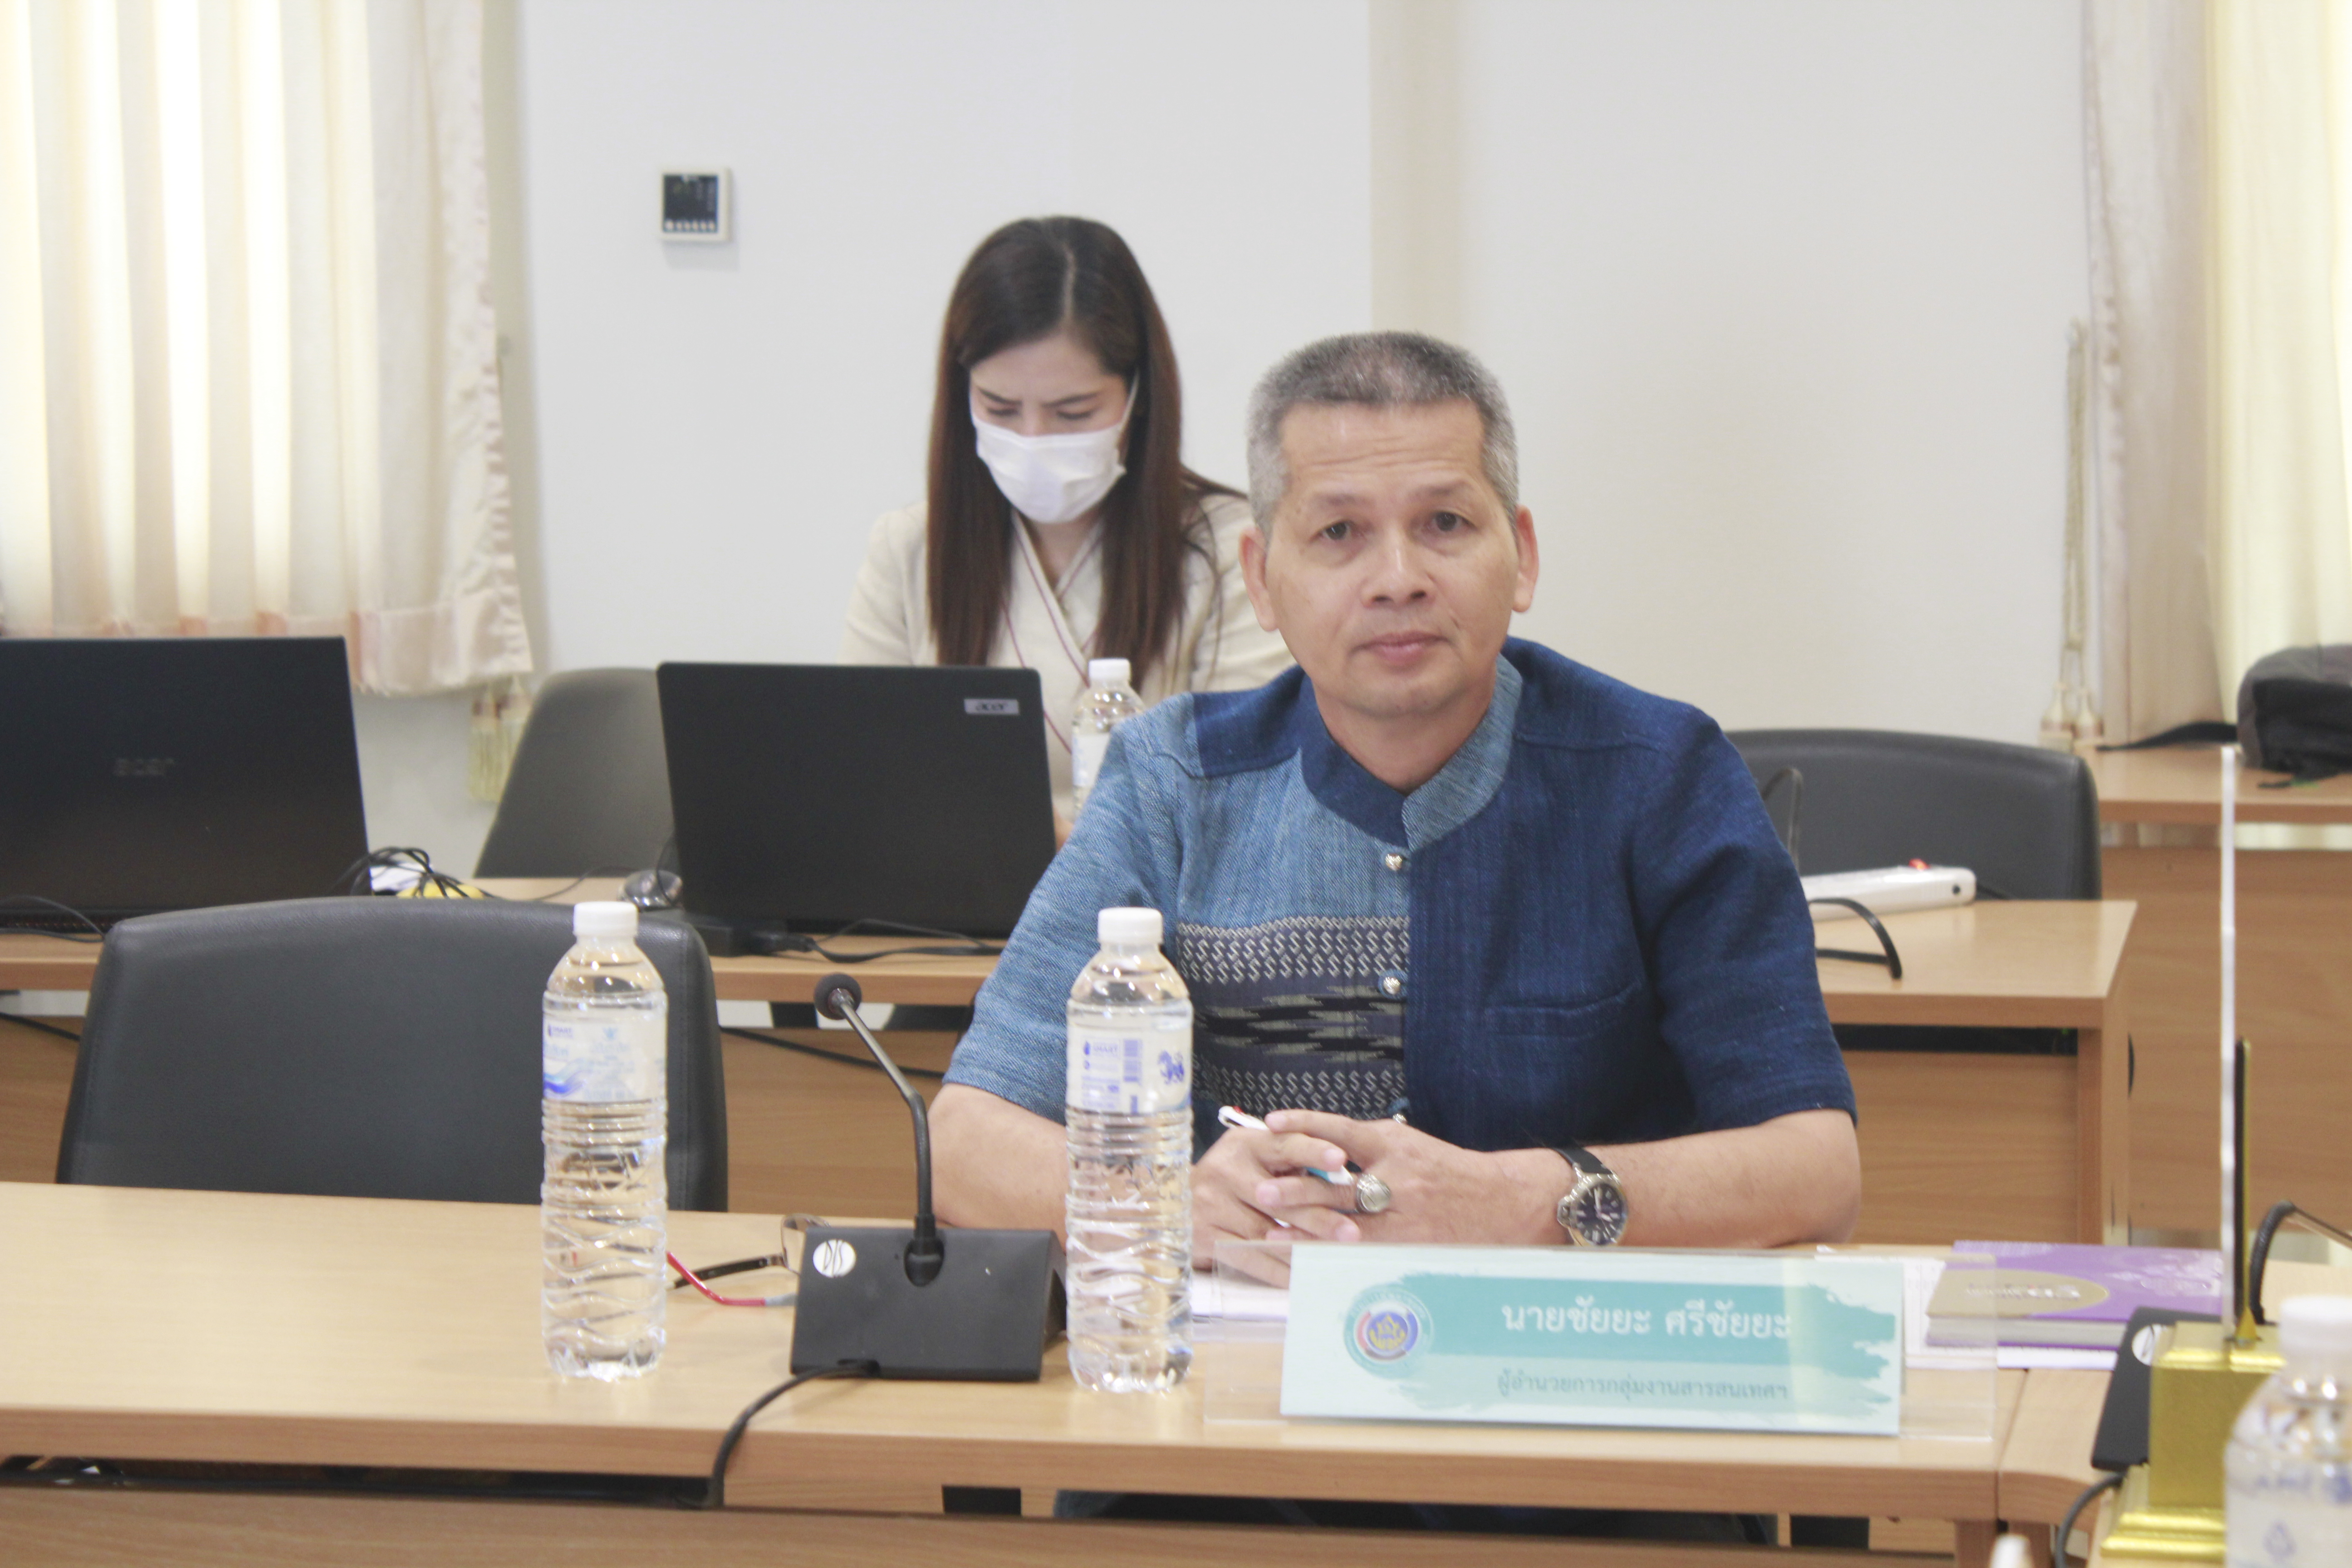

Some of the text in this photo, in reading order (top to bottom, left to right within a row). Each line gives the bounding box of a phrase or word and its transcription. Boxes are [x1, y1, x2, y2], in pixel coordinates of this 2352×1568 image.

[1502, 1295, 1791, 1339] นายชัยยะ ศรีชัยยะ
